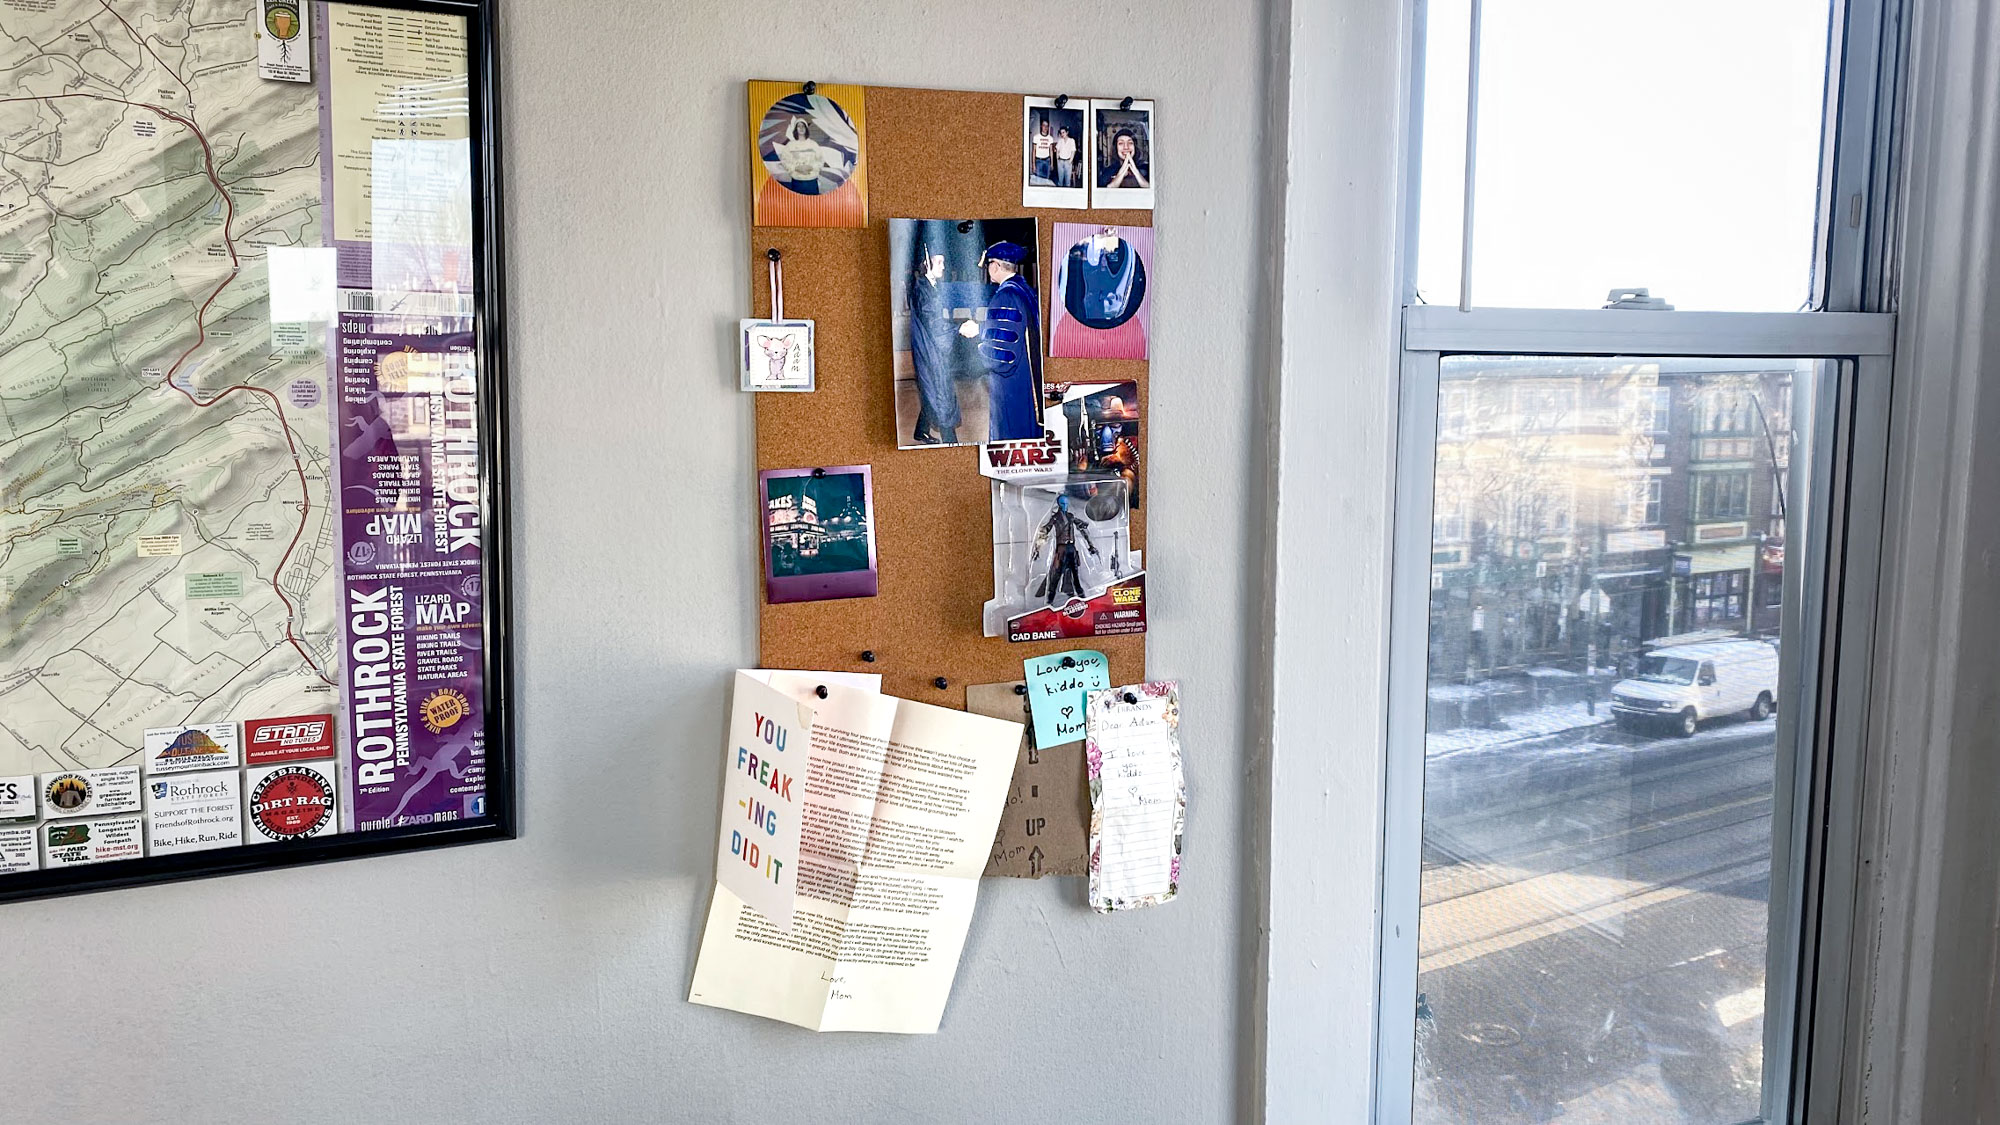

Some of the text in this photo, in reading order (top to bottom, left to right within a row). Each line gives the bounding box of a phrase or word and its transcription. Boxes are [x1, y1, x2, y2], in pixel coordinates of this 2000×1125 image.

[343, 338, 392, 346] contemplating
[344, 357, 373, 365] camping
[345, 377, 370, 385] boating
[345, 396, 367, 404] hiking
[444, 352, 482, 552] ROTHROCK
[987, 448, 1061, 467] WARS
[432, 466, 448, 554] STATE FOREST
[366, 513, 422, 536] MAP
[386, 534, 422, 544] LIZARD
[415, 594, 451, 605] LIZARD
[416, 602, 471, 625] MAP
[1114, 610, 1140, 619] WARNING:
[1011, 631, 1056, 641] CAD BANE
[1076, 658, 1100, 672] you,
[390, 585, 410, 767] PENNSYLVANIA STATE FOREST
[350, 586, 394, 786] ROTHROCK
[1045, 678, 1083, 696] kiddo
[430, 699, 456, 716] WATER
[434, 708, 460, 723] PROOF
[754, 712, 787, 752] YOU
[1056, 722, 1085, 736] Mom
[737, 746, 793, 802] FREAK
[45, 774, 92, 802] GREENWOOD FURNACE
[170, 781, 228, 797] Rothrock
[252, 767, 332, 802] CELEBRATING
[368, 786, 389, 794] Edition
[297, 796, 331, 805] RAG
[155, 809, 188, 818] SUPPORT
[738, 796, 777, 836] -ING
[156, 816, 234, 830] FriendsofRothrock.org
[254, 809, 332, 840] THIRTY YEARS
[1026, 817, 1046, 836] UP
[96, 844, 138, 852] hike-mst.org
[154, 839, 174, 847] Bike,
[175, 837, 197, 845] Hike,
[199, 834, 218, 842] Run,
[731, 830, 782, 884] DID IT
[994, 845, 1025, 866] Mom
[821, 971, 846, 984] Love,
[831, 990, 852, 1000] Mom
